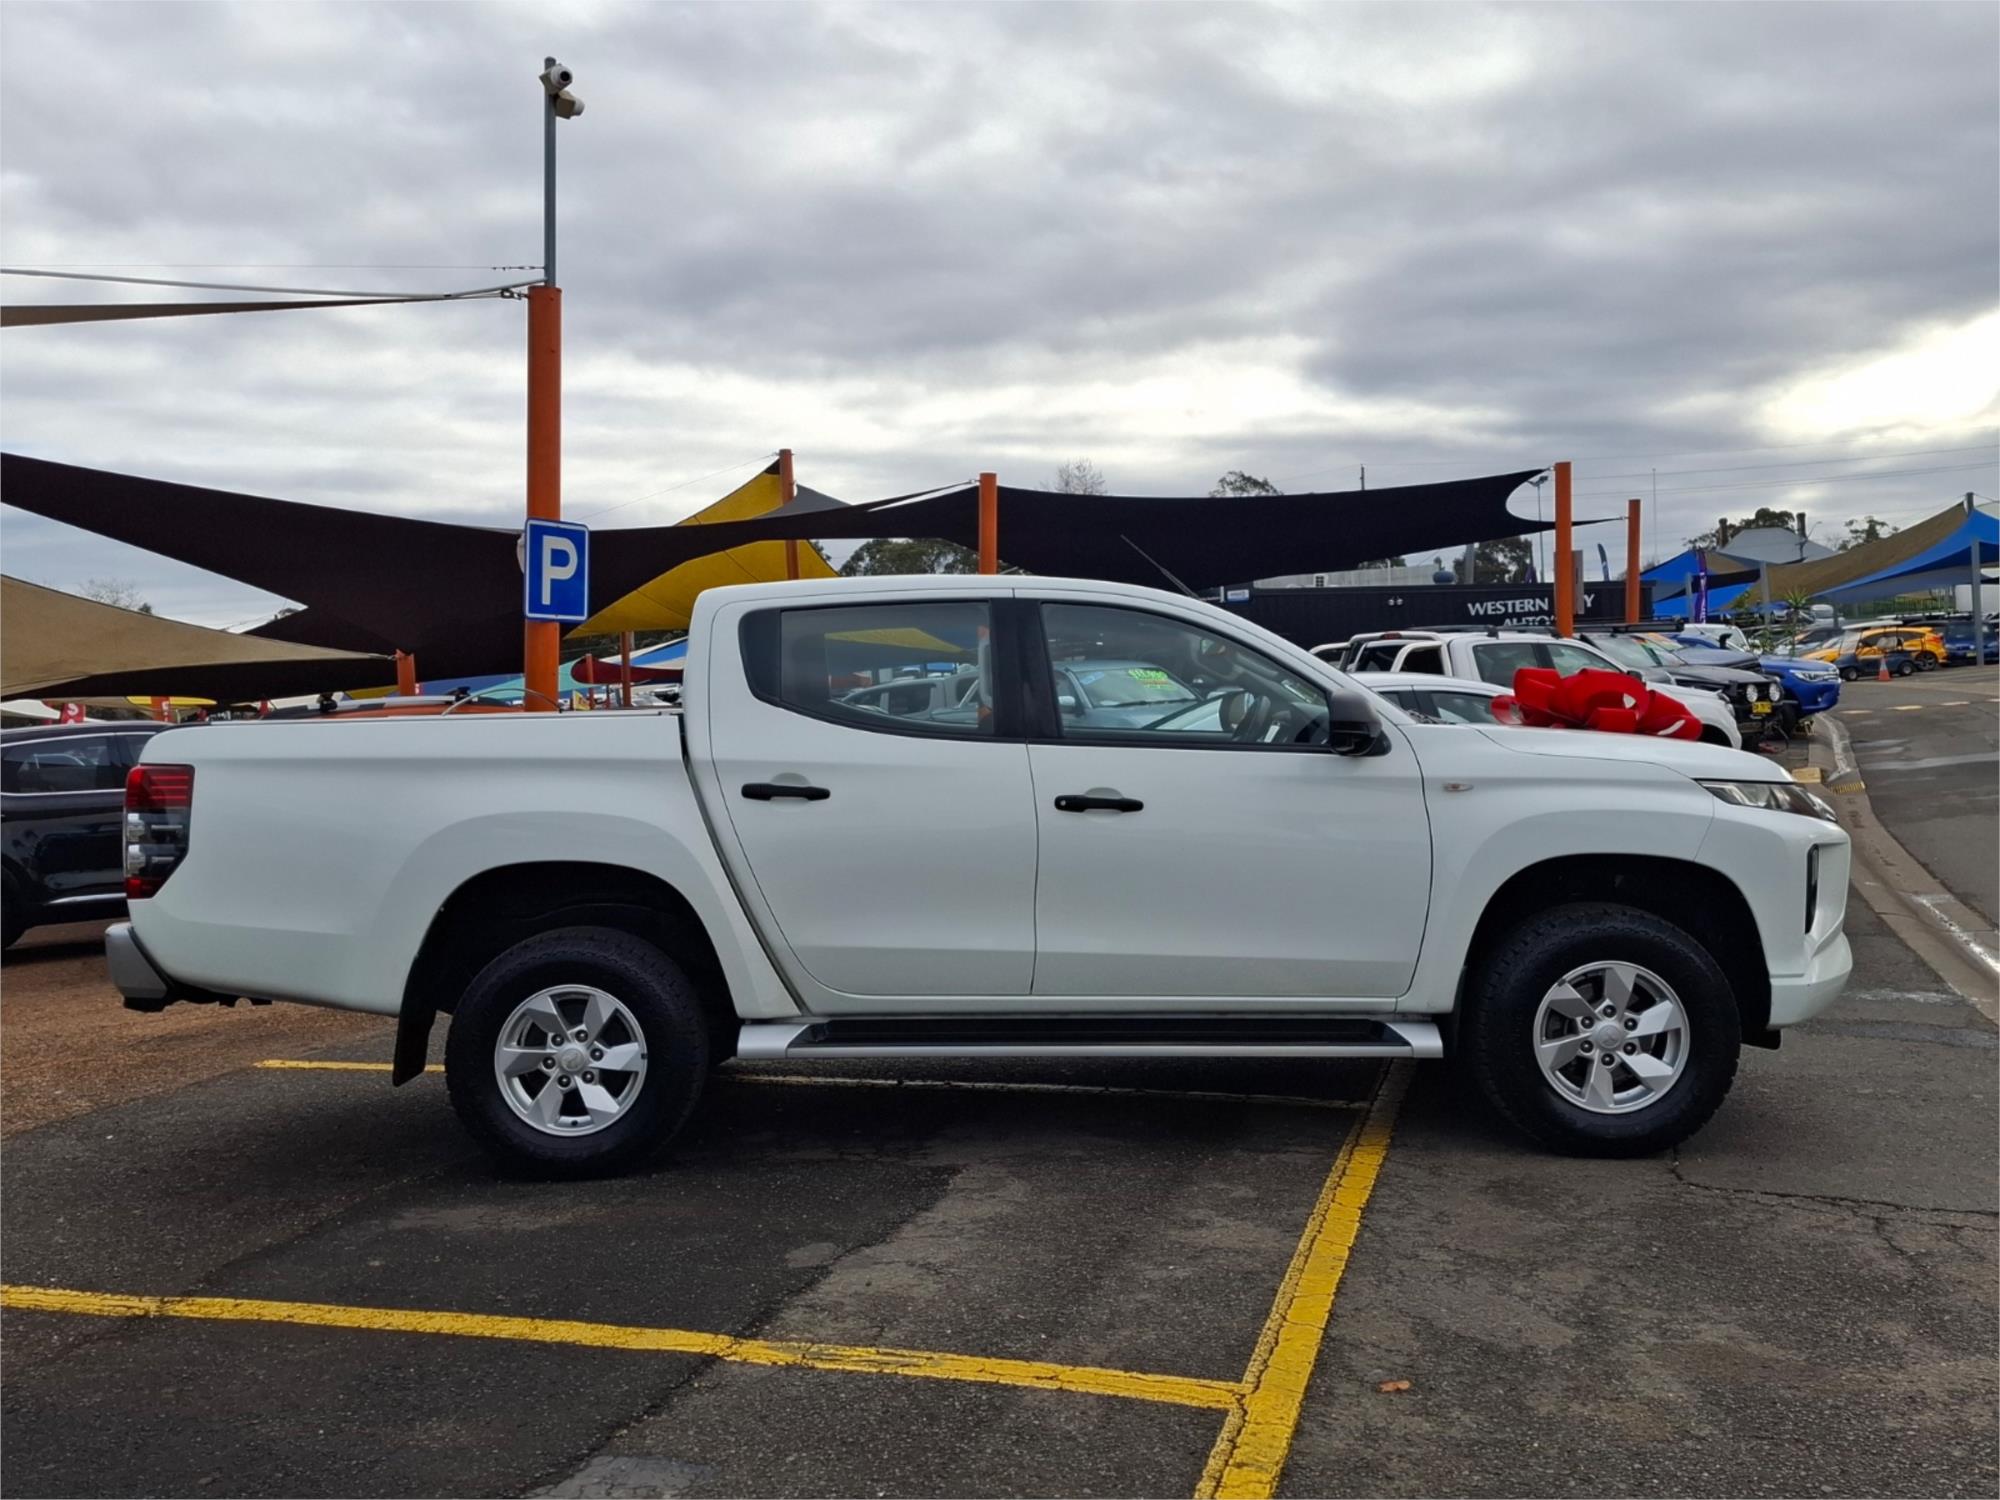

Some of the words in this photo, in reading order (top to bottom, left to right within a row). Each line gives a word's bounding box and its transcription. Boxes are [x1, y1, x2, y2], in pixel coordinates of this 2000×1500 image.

[541, 534, 578, 606] P
[1467, 597, 1549, 616] WESTERN
[1503, 615, 1556, 627] AUTO
